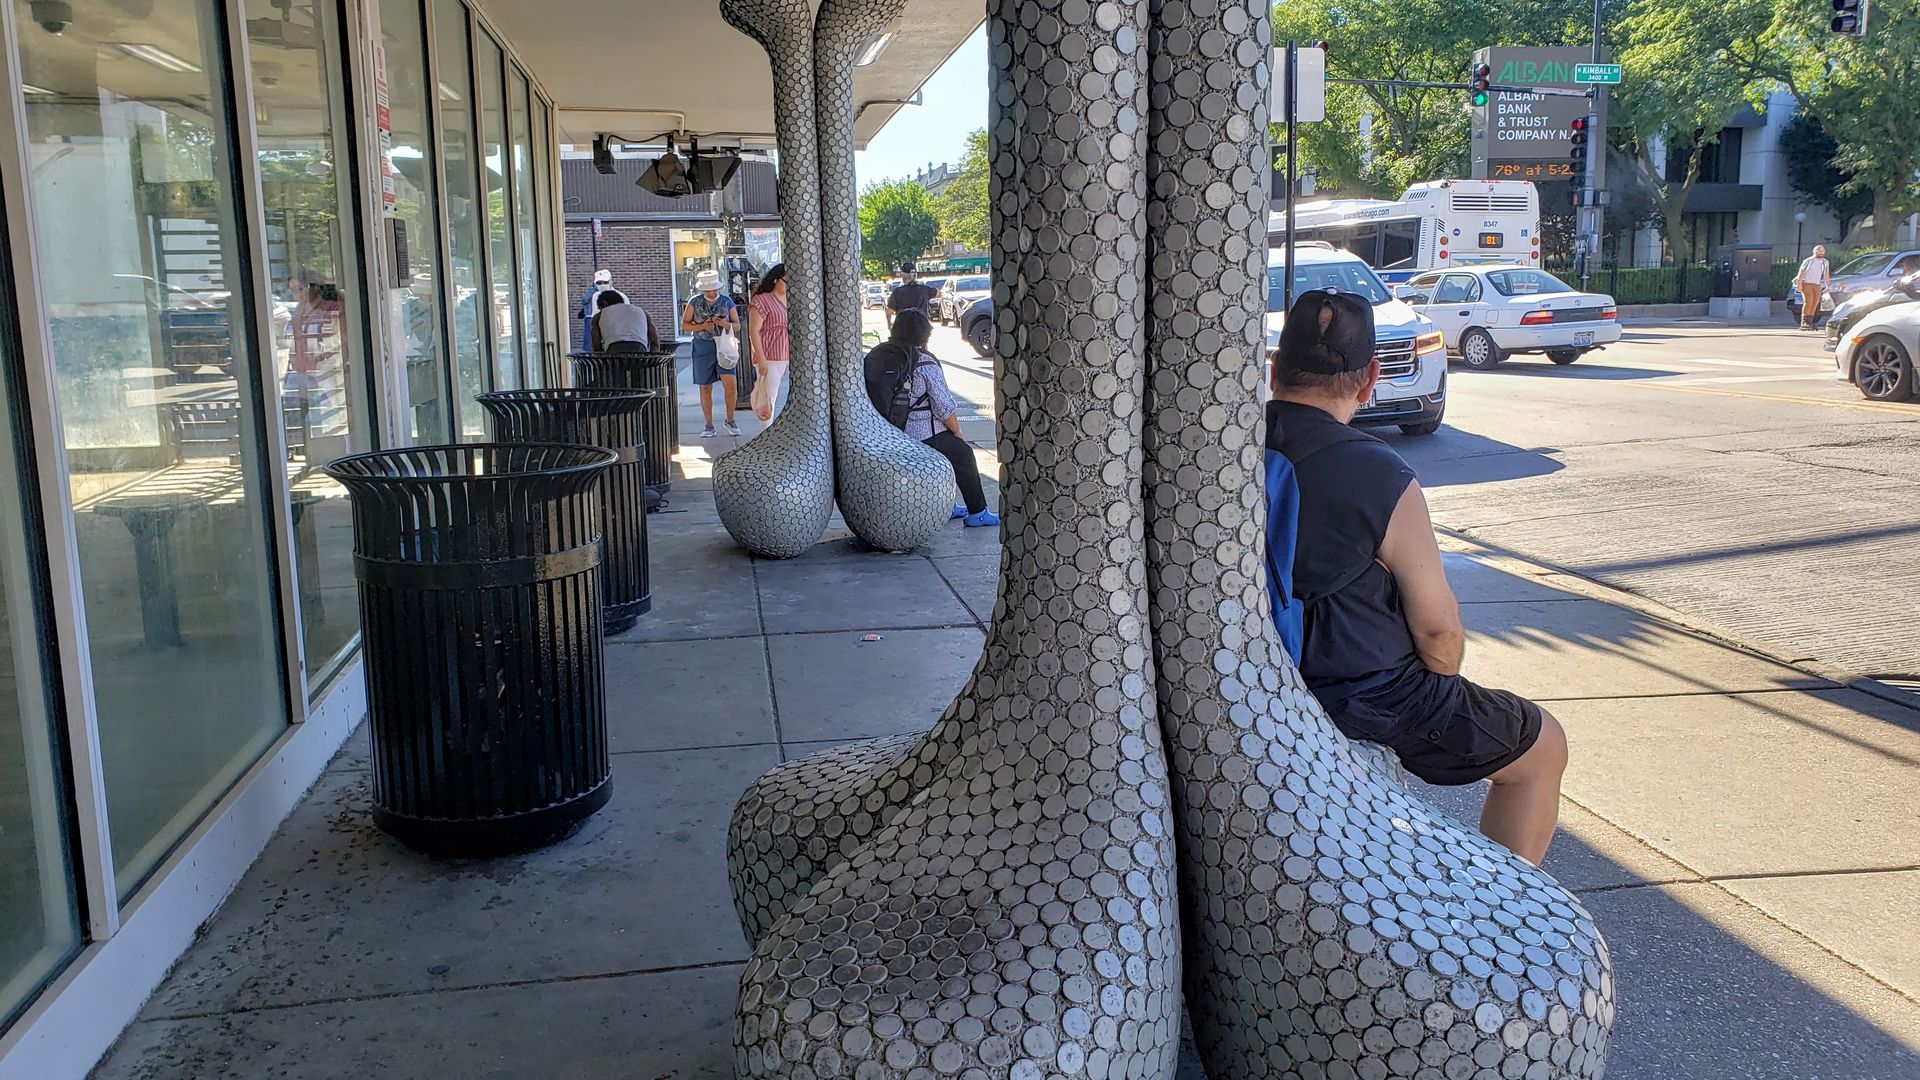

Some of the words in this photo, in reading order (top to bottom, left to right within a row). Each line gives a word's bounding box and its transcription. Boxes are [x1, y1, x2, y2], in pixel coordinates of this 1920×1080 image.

[1582, 66, 1613, 74] KIMBALL
[1498, 103, 1532, 114] BANK
[1498, 117, 1506, 127] &
[1509, 116, 1549, 127] TRUST
[1498, 129, 1557, 140] COMPANY
[1526, 164, 1543, 176] at
[1483, 220, 1498, 228] 8347
[1486, 235, 1497, 245] 81
